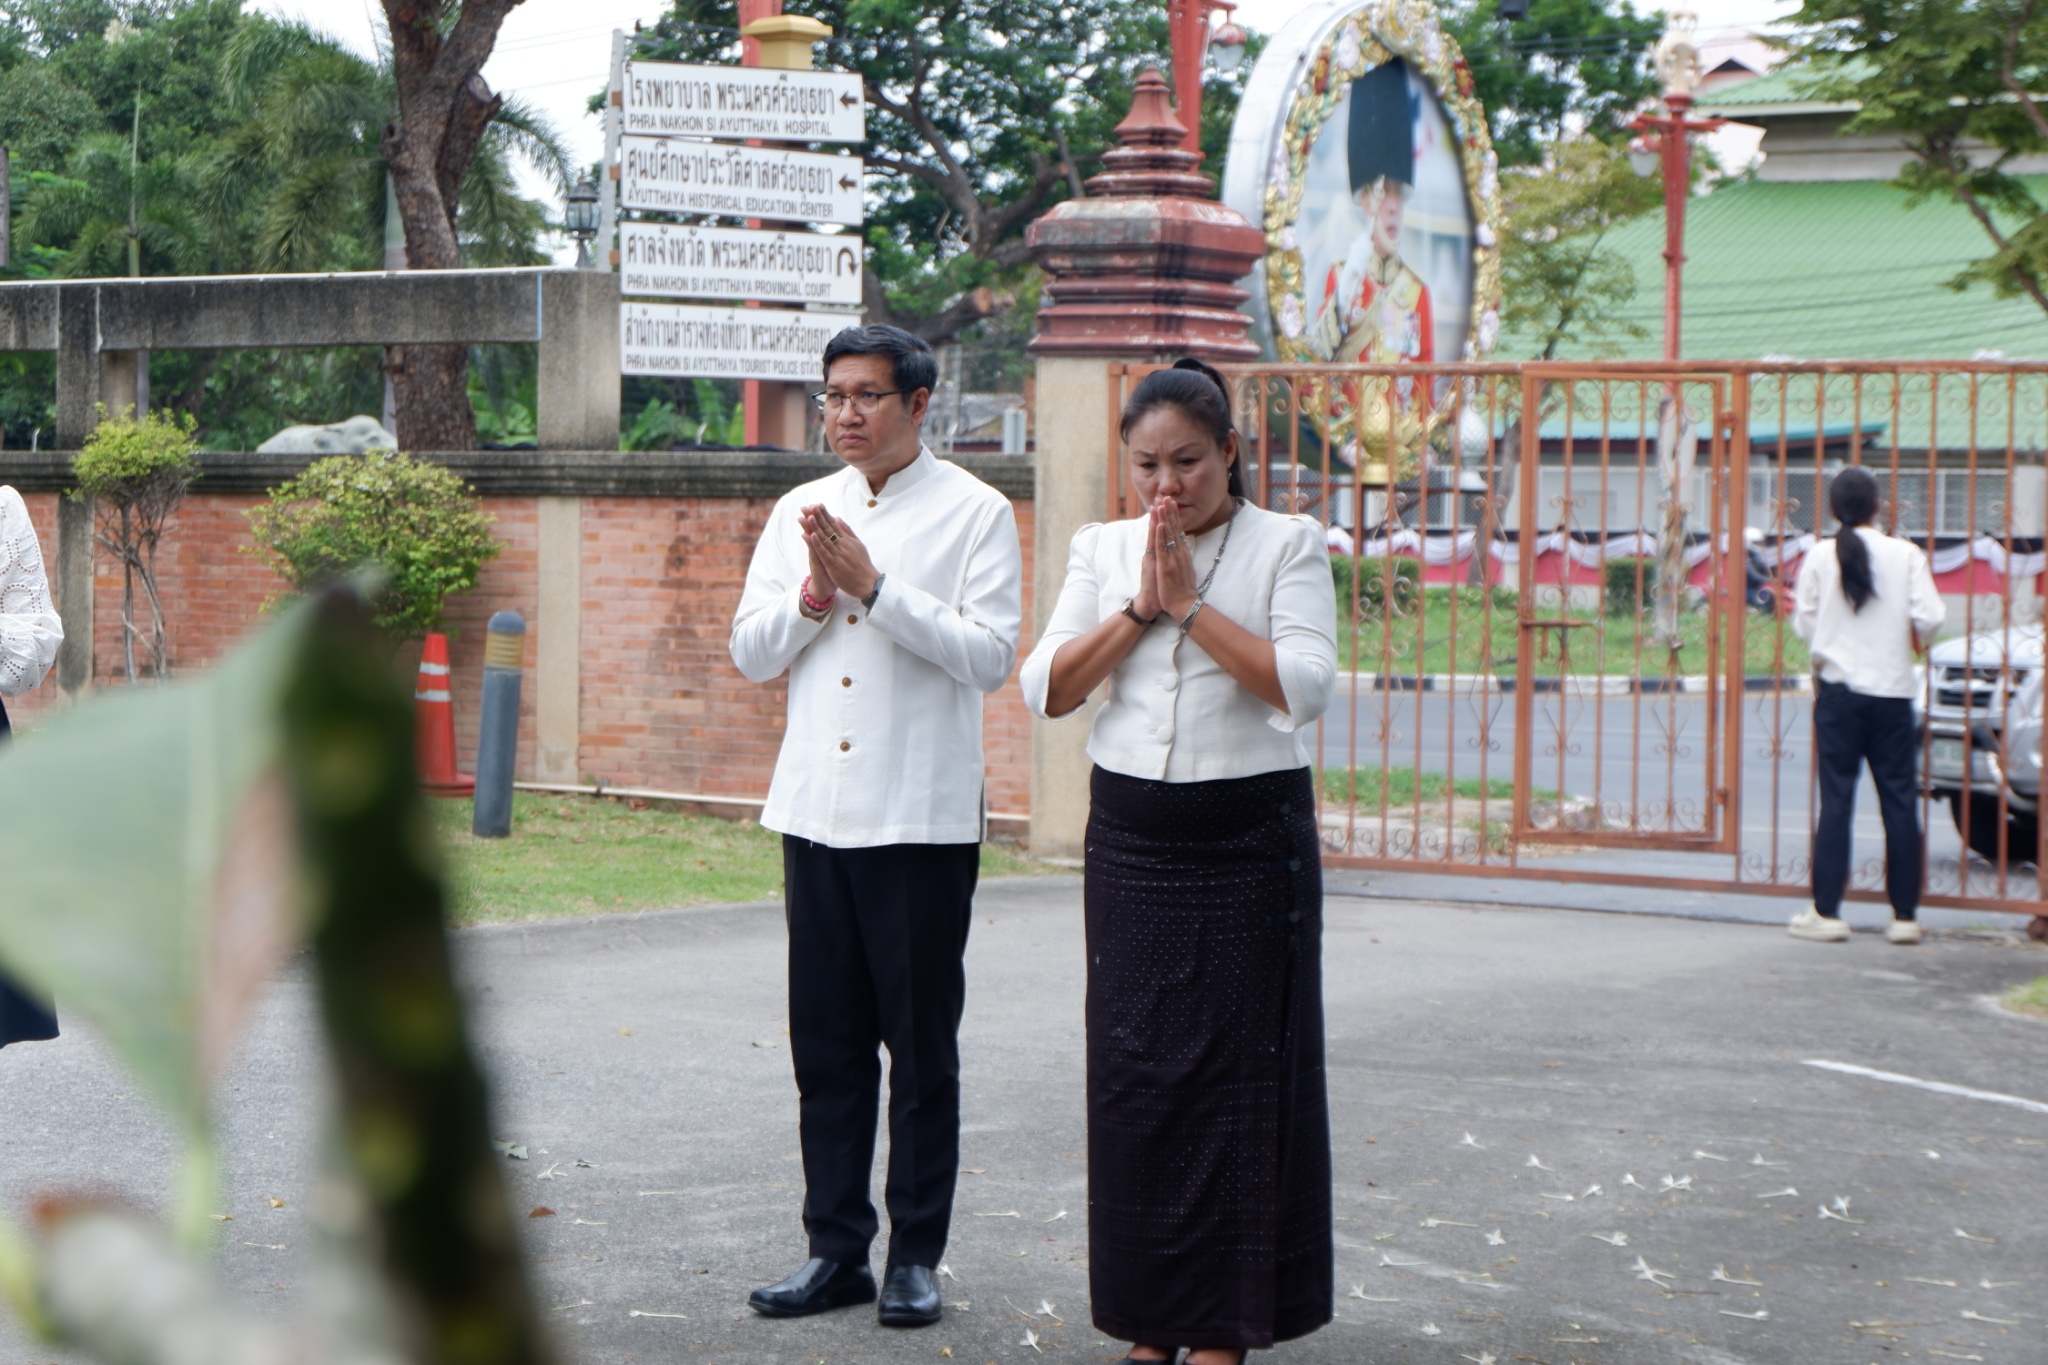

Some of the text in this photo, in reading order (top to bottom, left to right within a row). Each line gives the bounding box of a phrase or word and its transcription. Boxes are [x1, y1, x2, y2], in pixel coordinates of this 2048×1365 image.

[625, 61, 835, 120] โรงพยาบาล พระนครศรีอยุธยา
[630, 113, 832, 136] PHRA NAKHON SI AYUTTHAYA HOSPITAL
[628, 187, 833, 218] AYUTTHAYA HISTORICAL EDUCATION CENTER
[627, 226, 833, 280] ศาลจังหวัด พระนครศรีอยุธยา
[627, 273, 832, 298] PHRA NAKHON SI AYUTTHAYA PROVINCIAL COURT
[626, 354, 823, 376] PHRA NAKHON SI AYUTTHAYA TOURIST POLICE STATI
